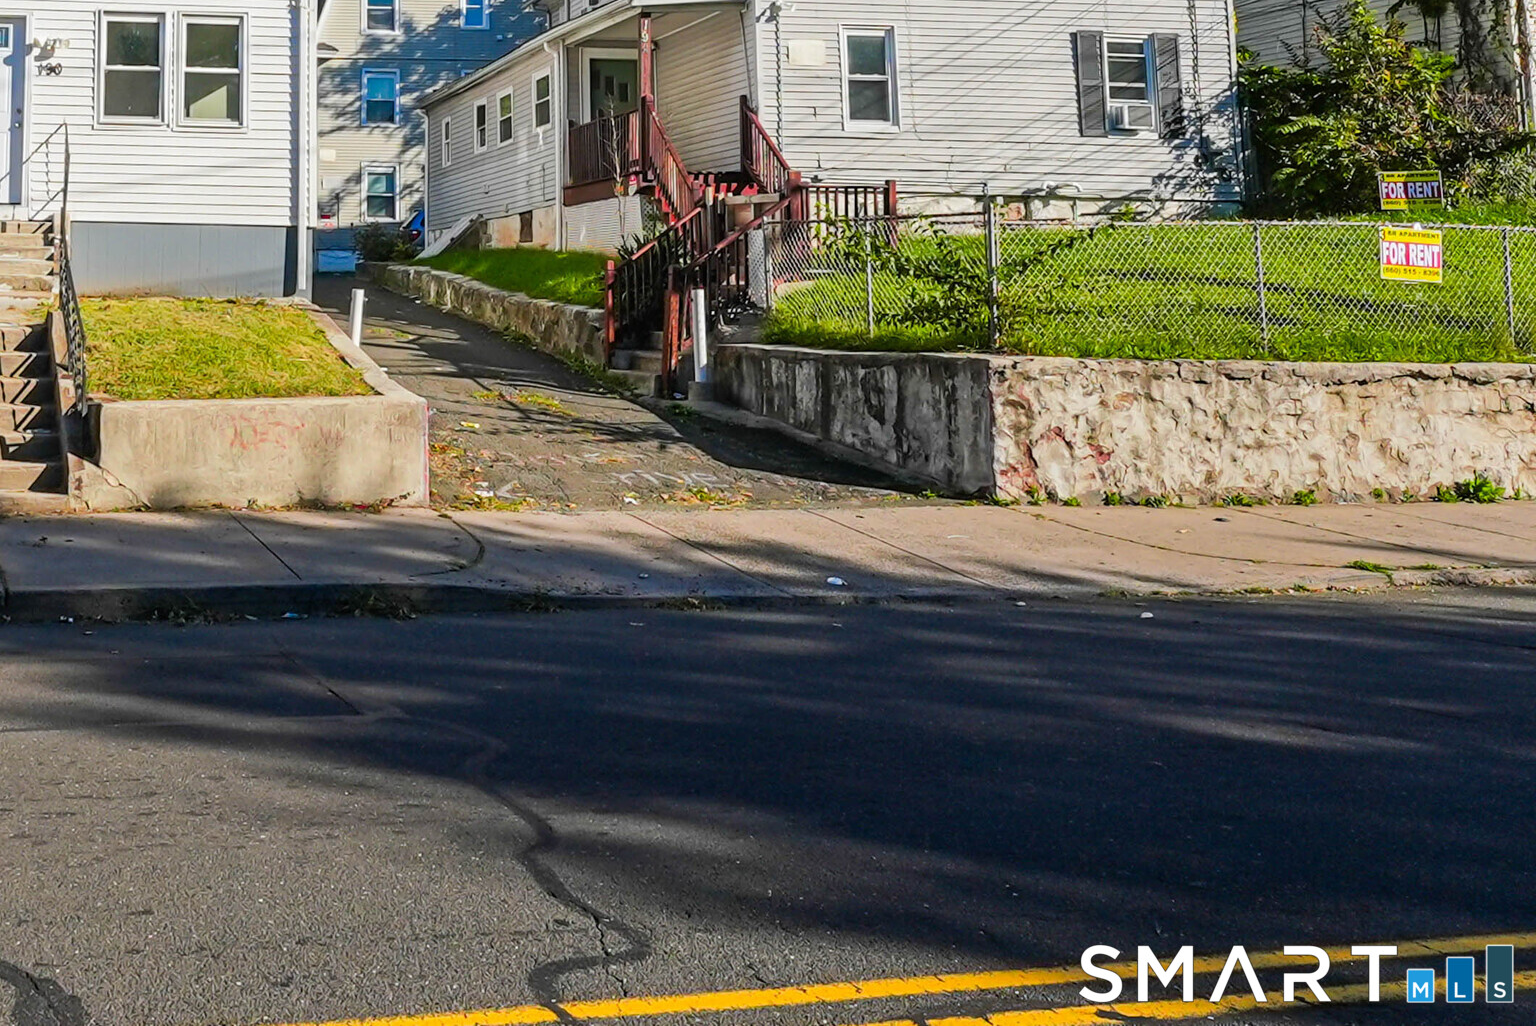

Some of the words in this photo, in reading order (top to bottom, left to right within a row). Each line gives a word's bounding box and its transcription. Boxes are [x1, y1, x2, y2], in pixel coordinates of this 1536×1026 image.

[1381, 182, 1406, 199] FOR
[1407, 181, 1439, 199] RENT
[1399, 231, 1440, 239] APARTMENT
[1382, 241, 1406, 265] FOR
[1409, 243, 1440, 268] RENT
